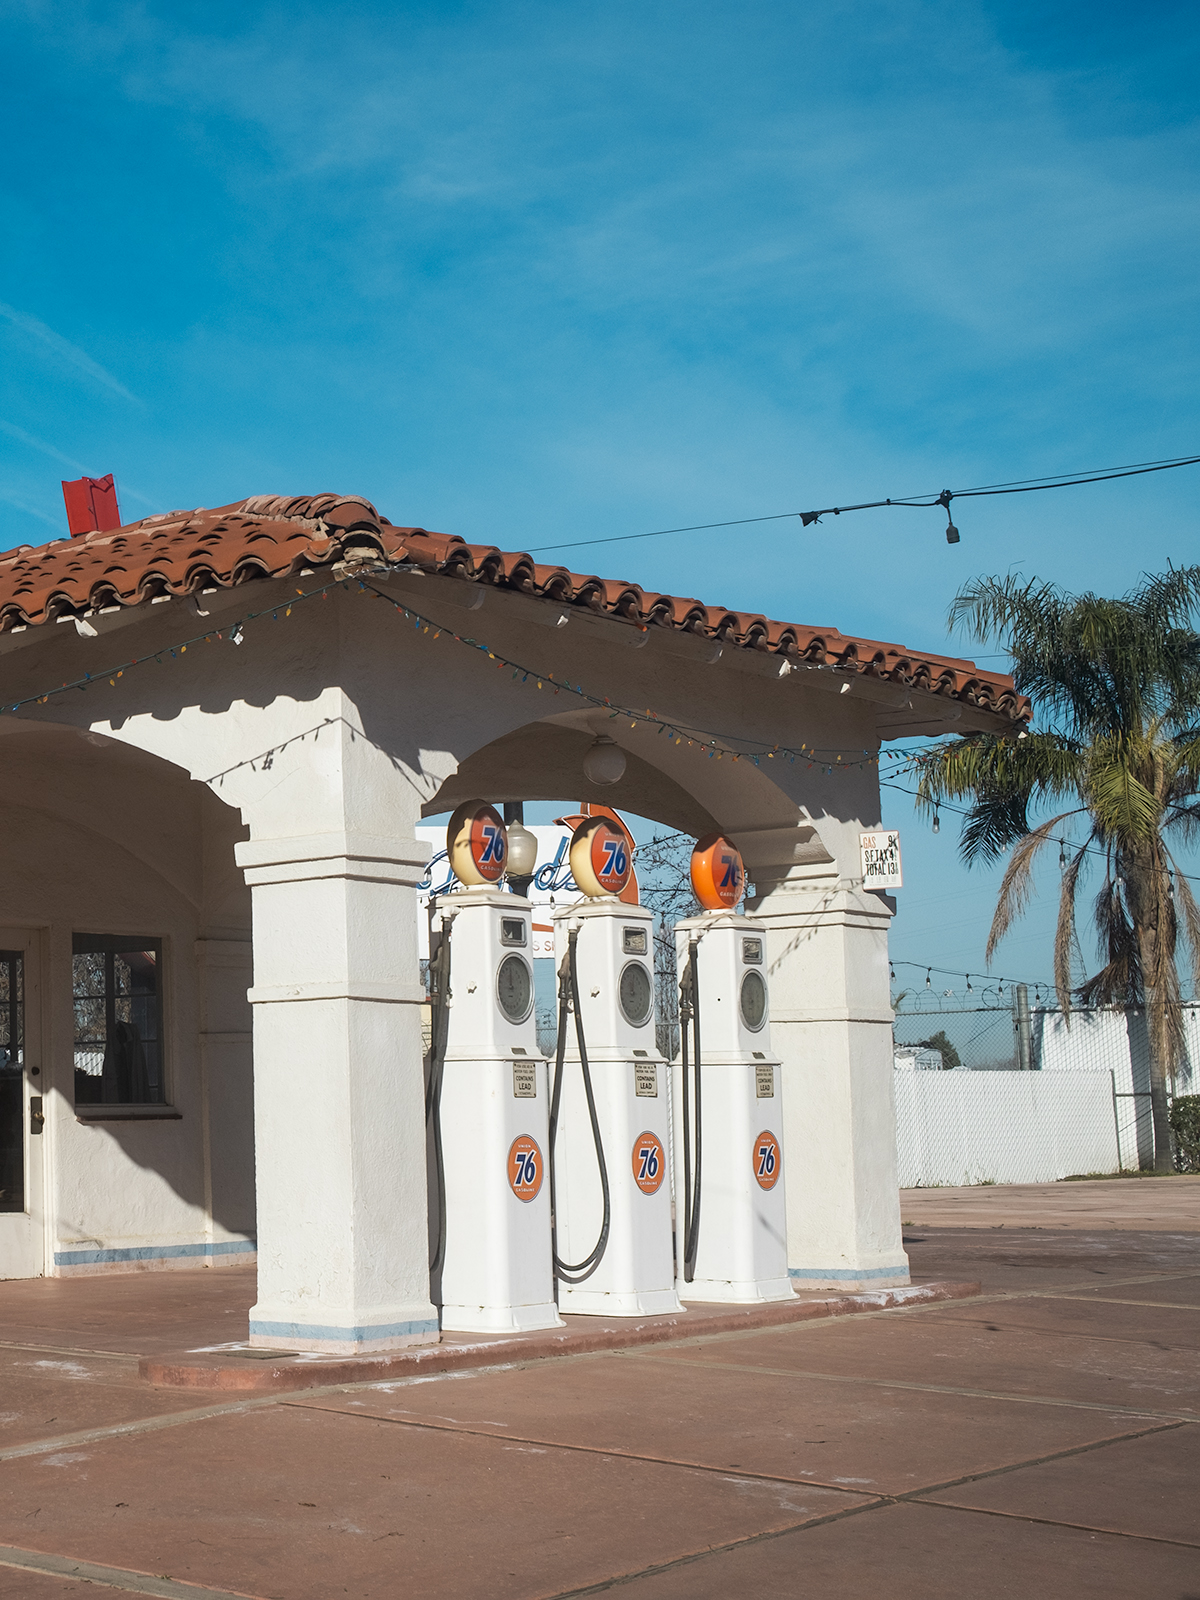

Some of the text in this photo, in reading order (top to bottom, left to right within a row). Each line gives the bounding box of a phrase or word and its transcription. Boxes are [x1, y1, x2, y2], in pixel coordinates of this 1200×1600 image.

[478, 825, 505, 863] 76
[599, 840, 627, 876] 76
[863, 836, 876, 849] GAS
[865, 863, 886, 876] TOTAL
[513, 1149, 537, 1186] 76
[637, 1145, 659, 1180] 76
[757, 1143, 776, 1176] 76
